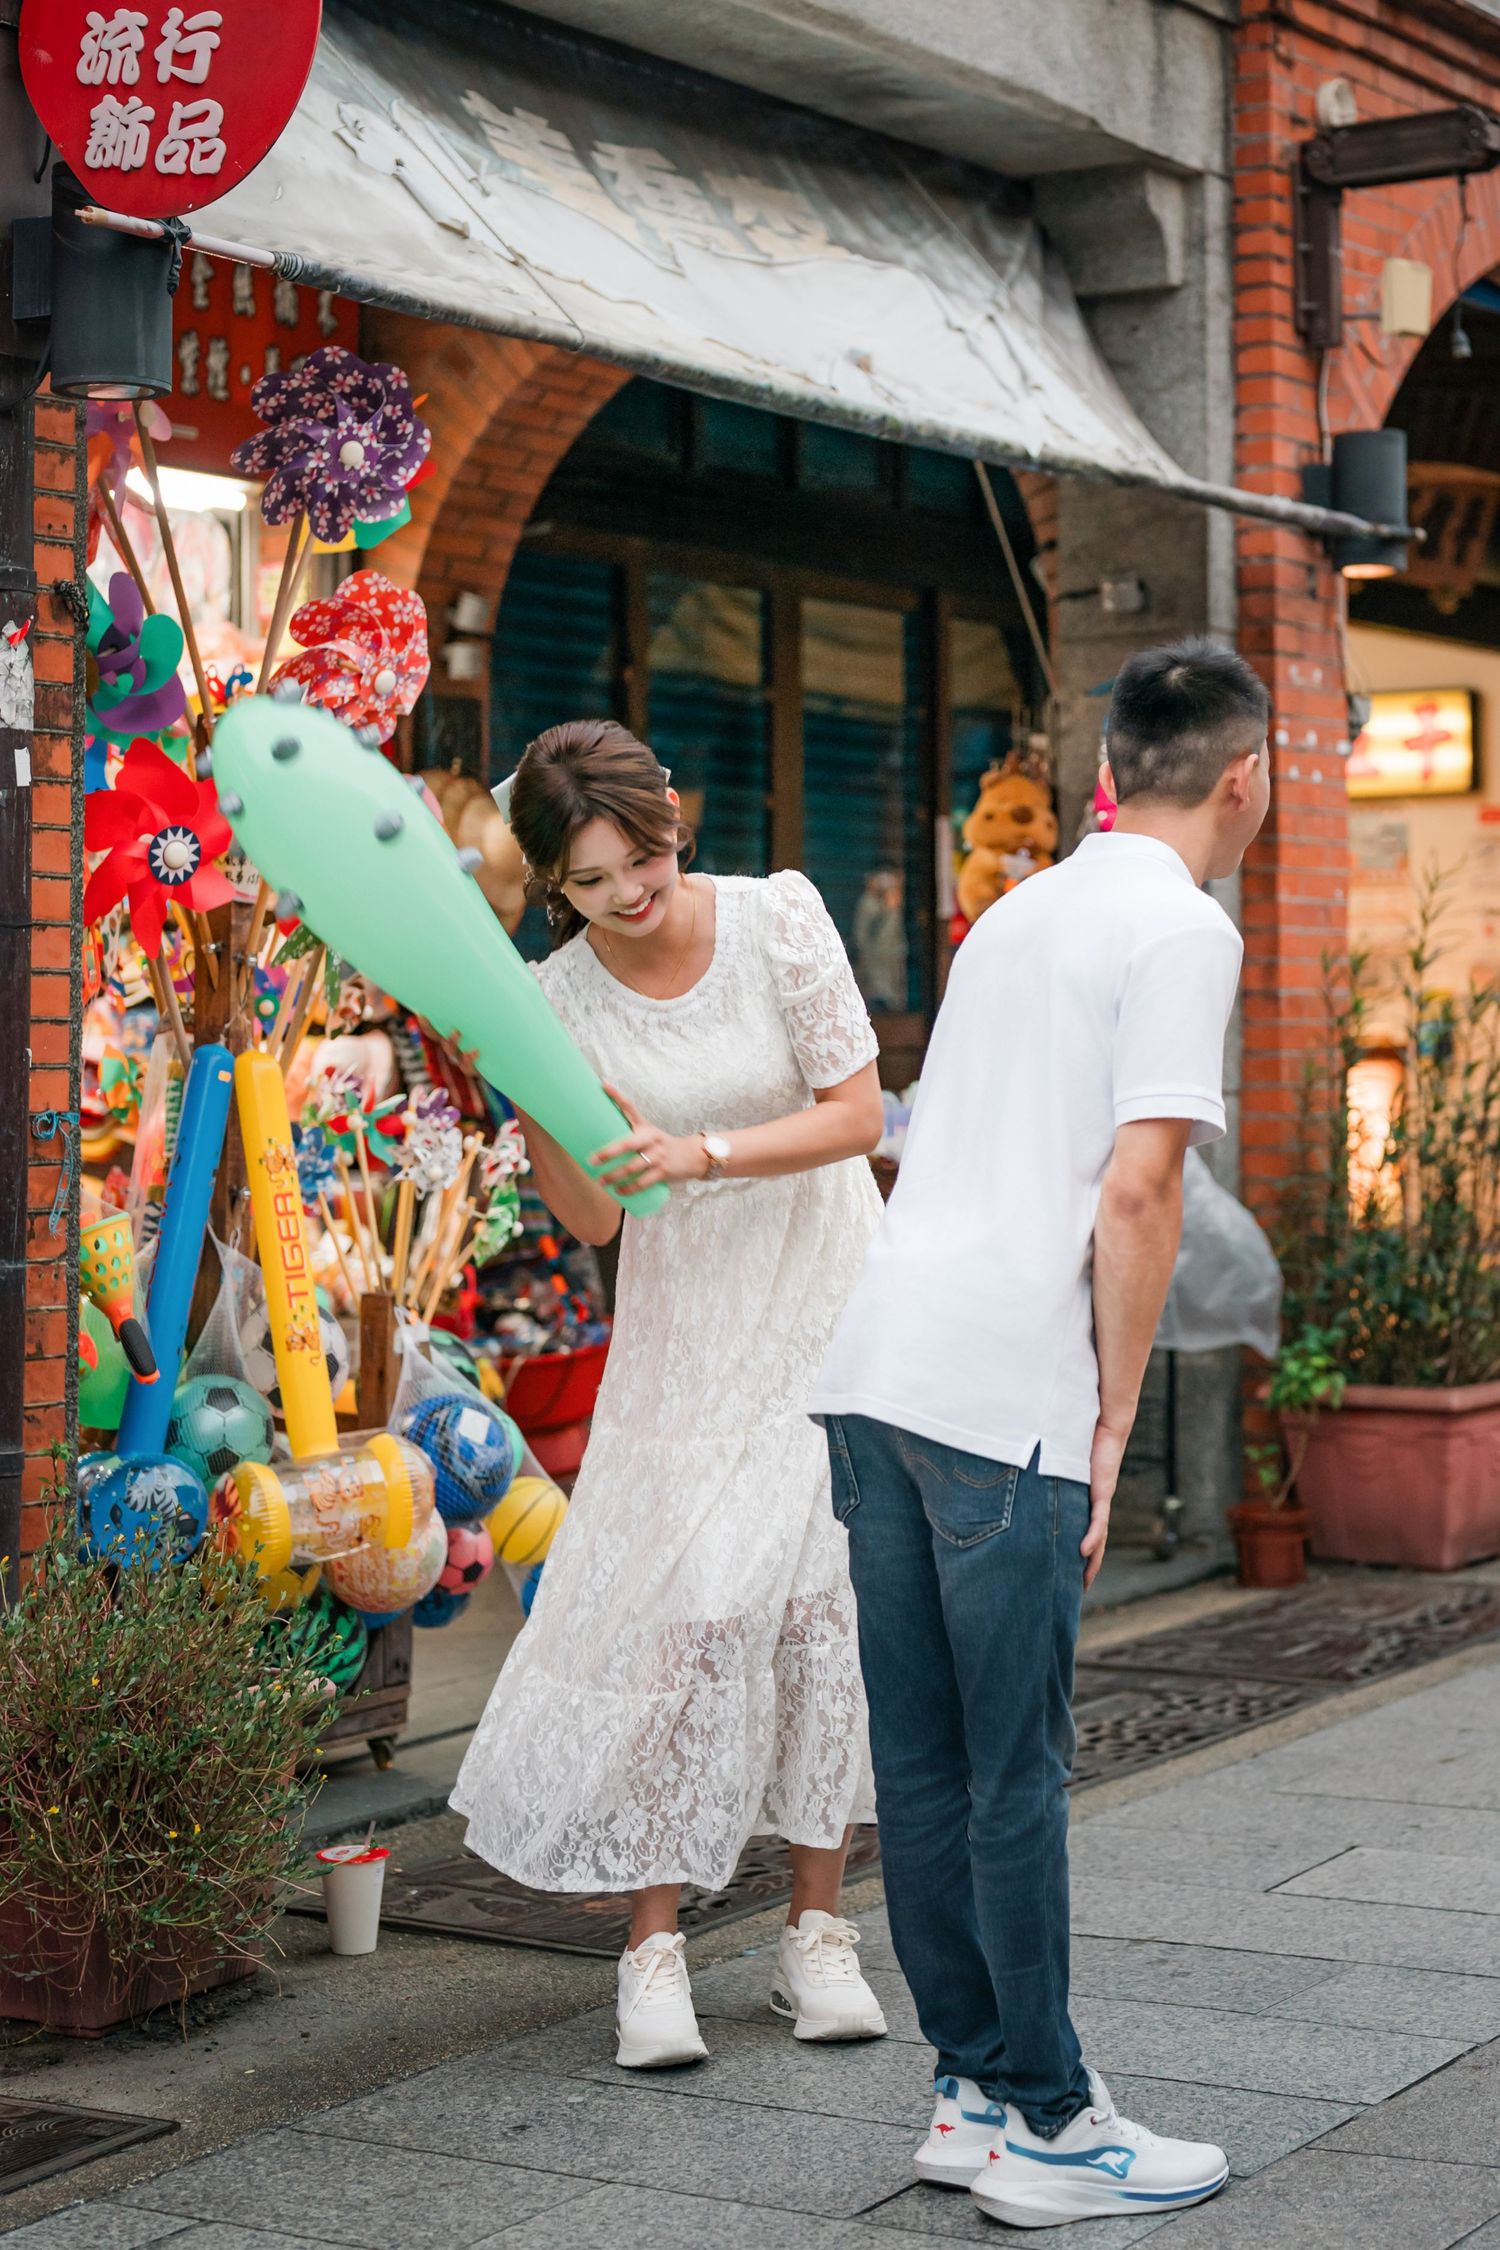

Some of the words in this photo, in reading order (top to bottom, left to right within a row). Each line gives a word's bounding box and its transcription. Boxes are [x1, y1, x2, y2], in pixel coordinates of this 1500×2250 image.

[76, 7, 223, 86] 流行
[84, 94, 227, 175] 飾品
[273, 1191, 310, 1310] TIGER
